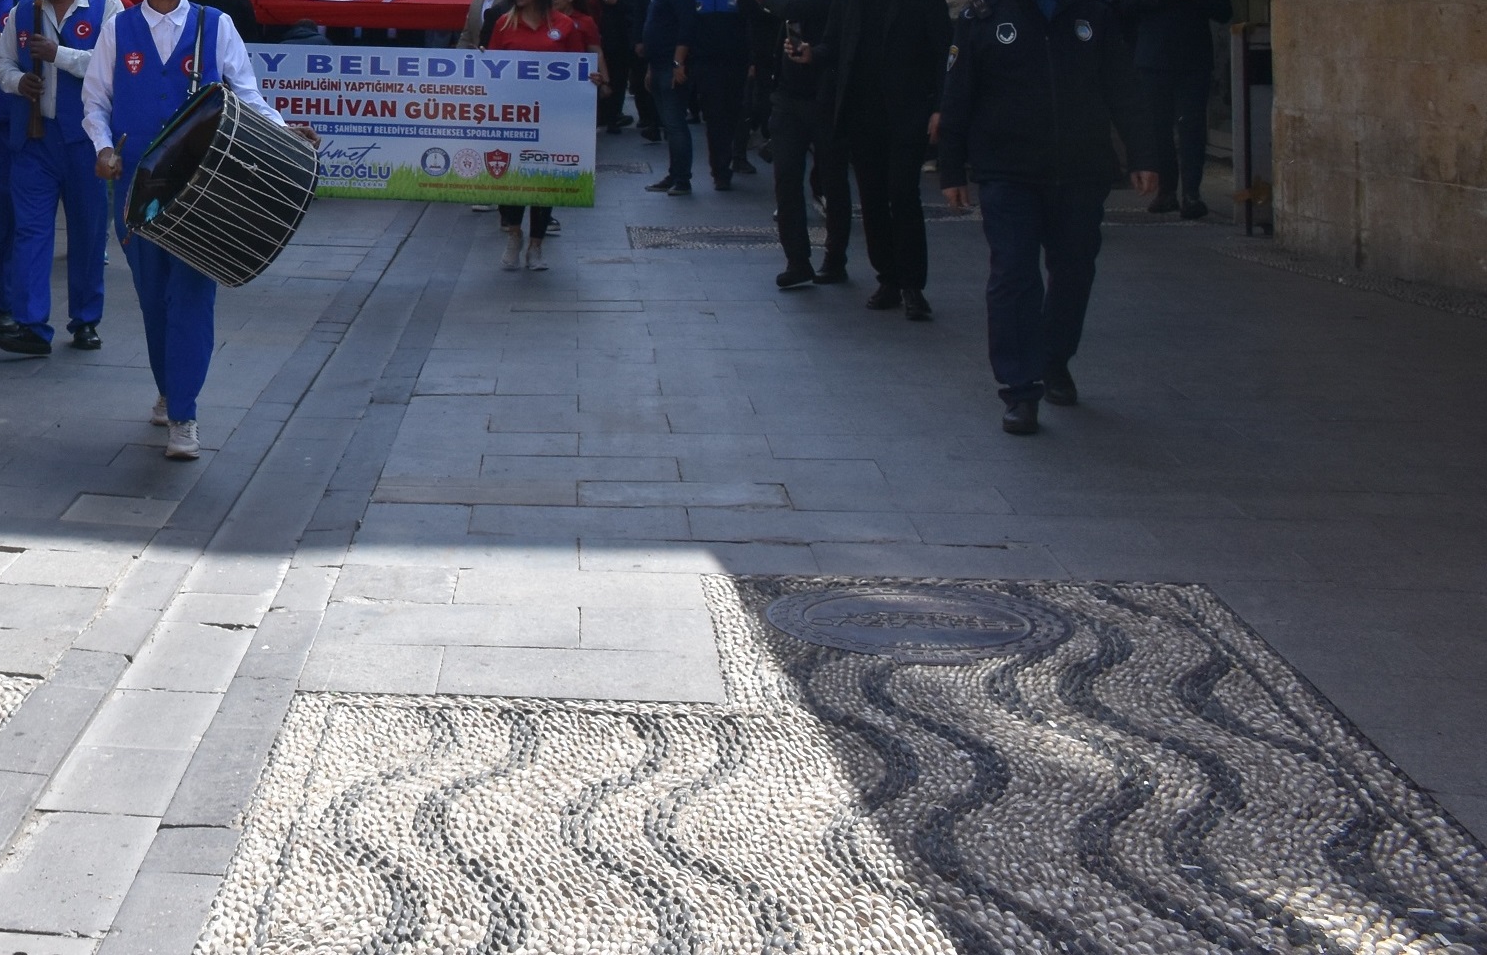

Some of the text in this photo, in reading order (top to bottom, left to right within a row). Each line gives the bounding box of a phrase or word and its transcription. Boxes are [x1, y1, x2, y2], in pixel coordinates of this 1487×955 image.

[307, 54, 589, 82] BELEDİYESİ
[262, 77, 488, 96] EV SAHİPLİĞİNİ YAPTIĞIMIZ 4. GELENEKSEL
[275, 94, 397, 117] PEHLİVAN
[404, 97, 540, 125] GÜREŞLERİ
[314, 124, 328, 133] YER
[335, 124, 372, 134] ŞAHİNBEY
[374, 125, 416, 135] BELEDİYESİ
[418, 127, 464, 137] GELENEKSEL
[467, 129, 501, 138] SPORLAR
[504, 130, 537, 140] MERKEZİ
